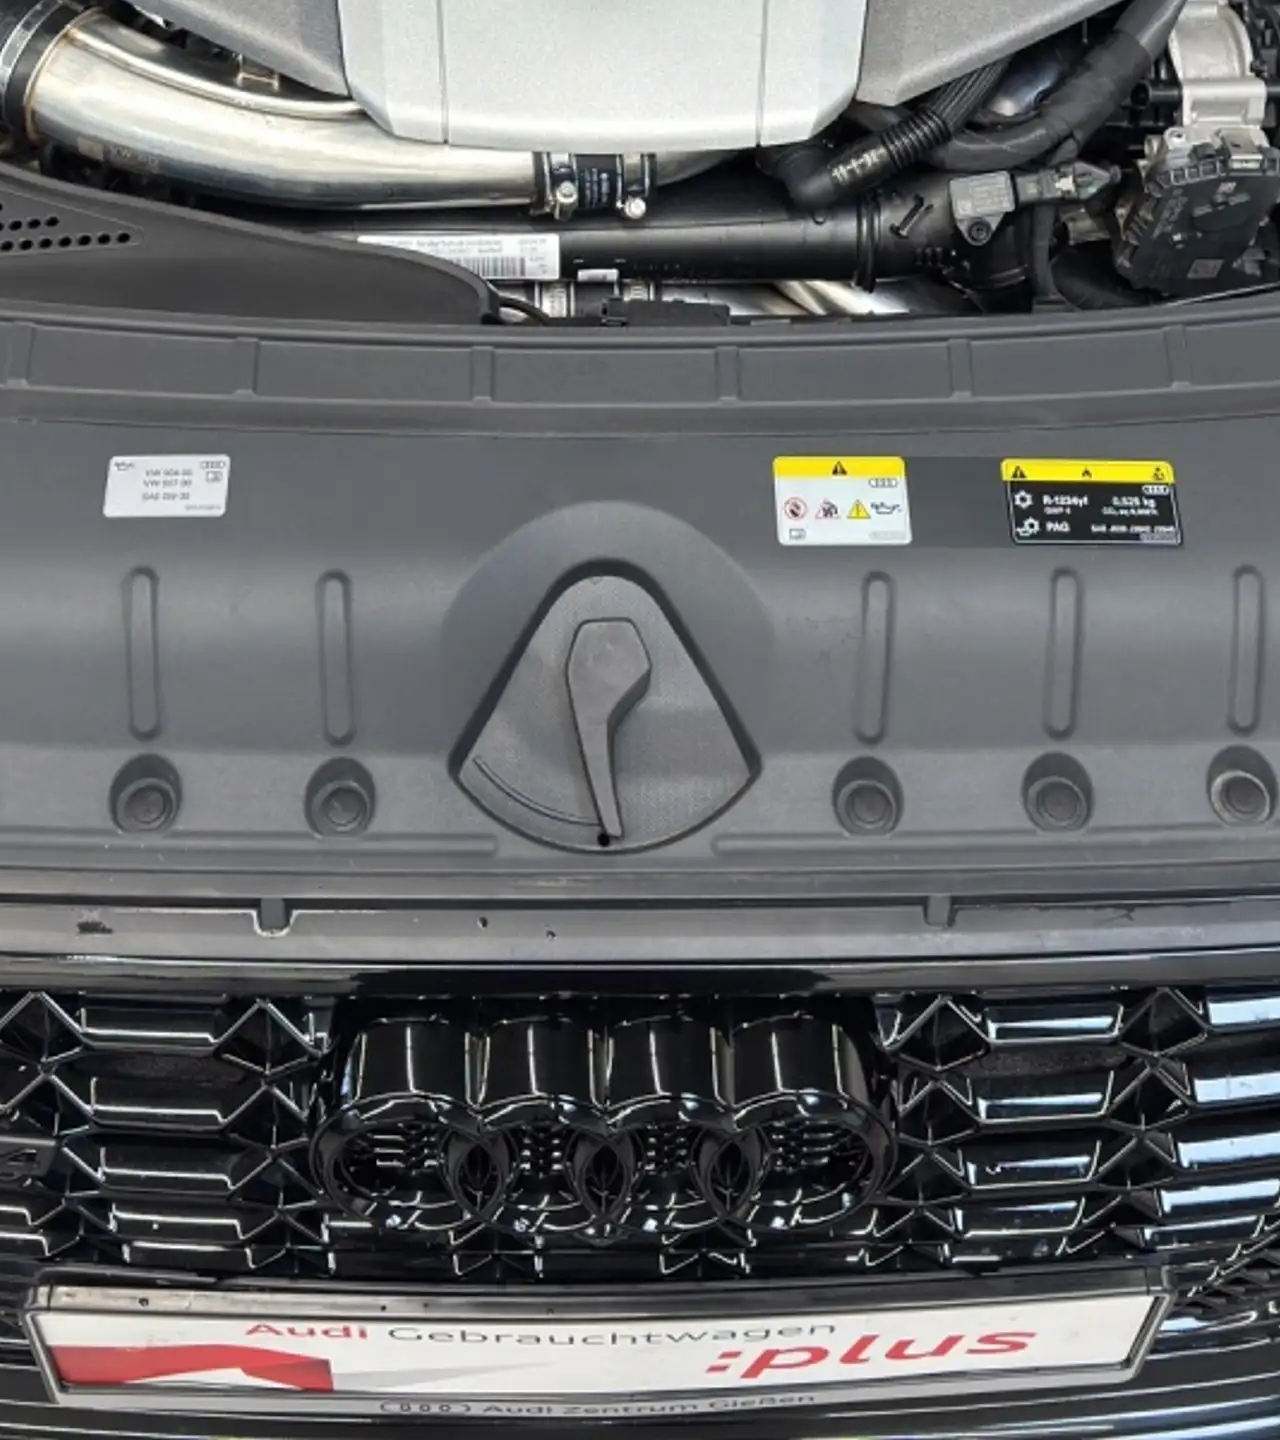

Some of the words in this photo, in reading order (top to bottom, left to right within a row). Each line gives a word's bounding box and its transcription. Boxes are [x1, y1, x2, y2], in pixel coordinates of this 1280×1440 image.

[245, 1323, 368, 1339] Audi
[388, 1324, 835, 1346] Gebrauchtwagen
[482, 1403, 552, 1414] Audi
[563, 1403, 698, 1415] Zentrum
